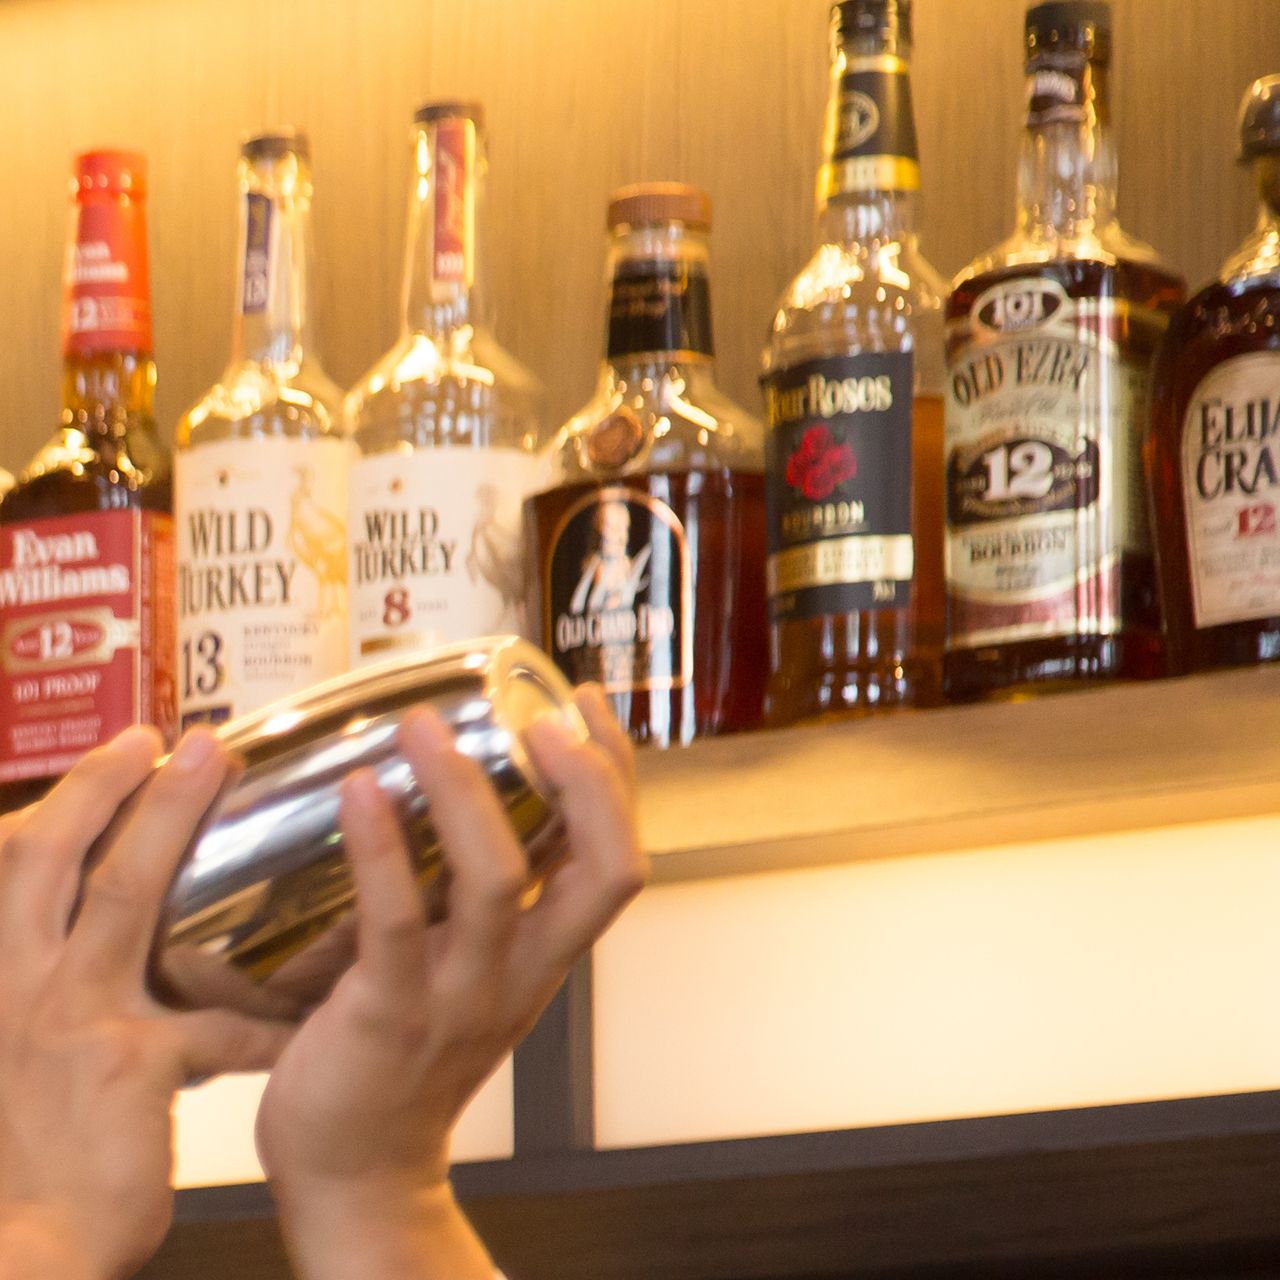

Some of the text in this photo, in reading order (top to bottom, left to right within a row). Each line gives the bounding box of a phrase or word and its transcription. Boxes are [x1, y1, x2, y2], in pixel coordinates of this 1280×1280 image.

[953, 351, 1005, 408] OLD
[983, 441, 1055, 501] 12
[189, 508, 274, 556] WILD
[365, 508, 439, 544] WILD
[1237, 503, 1276, 538] 12
[13, 528, 100, 568] Evan
[355, 540, 456, 586] TURKEY
[179, 558, 297, 618] TURKEY
[383, 585, 412, 629] 8
[42, 621, 74, 659] 12
[182, 630, 225, 700] 13
